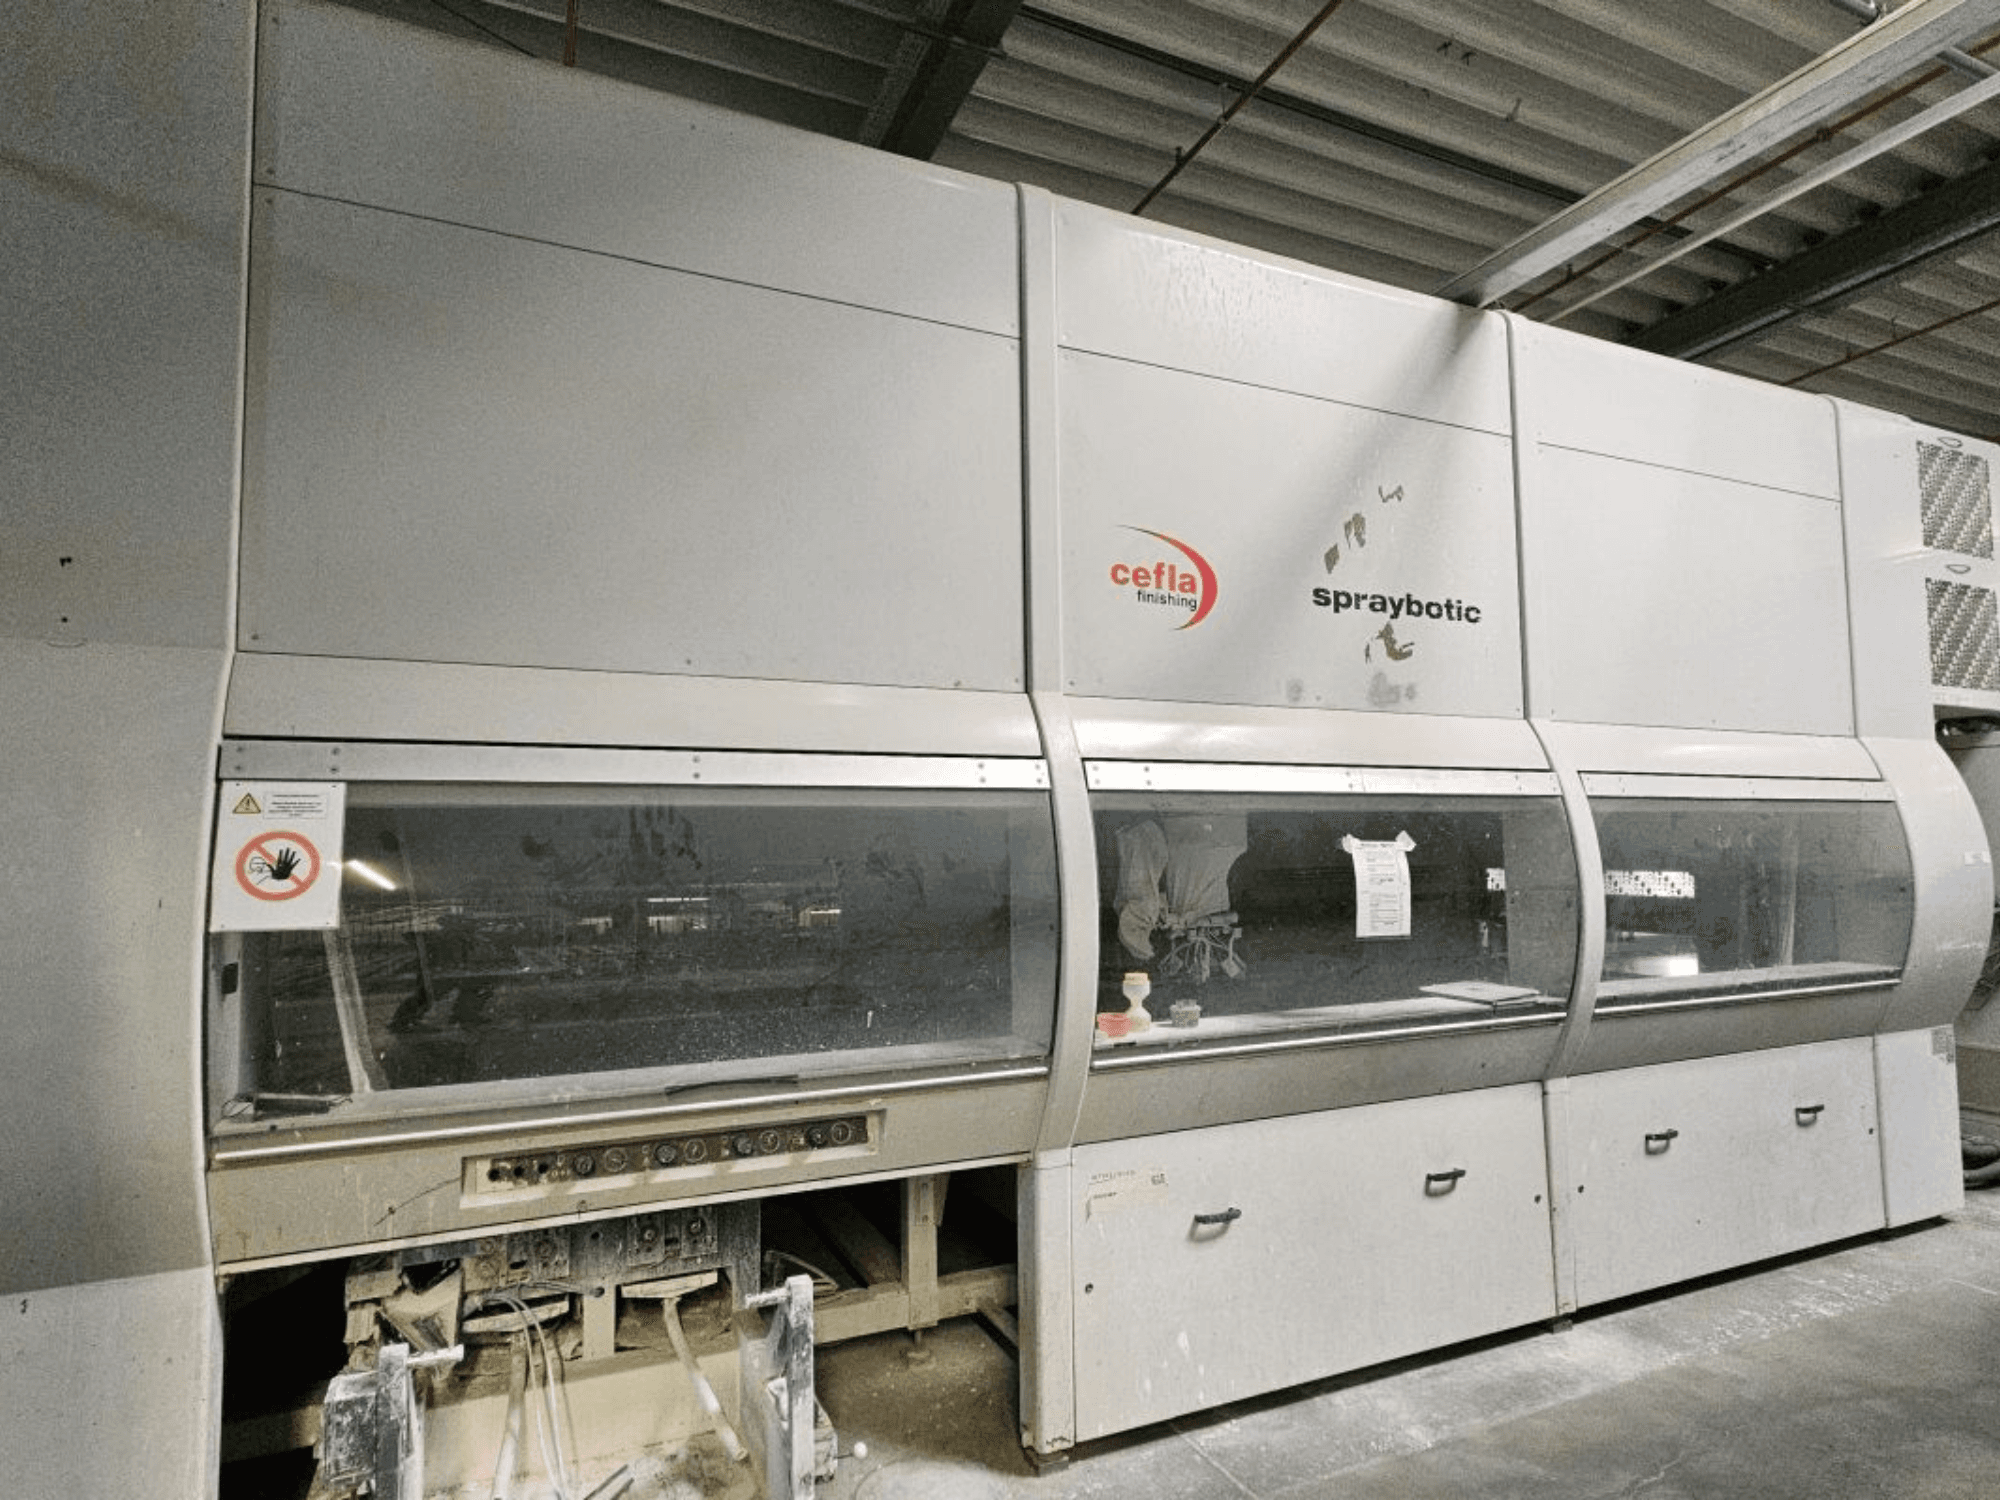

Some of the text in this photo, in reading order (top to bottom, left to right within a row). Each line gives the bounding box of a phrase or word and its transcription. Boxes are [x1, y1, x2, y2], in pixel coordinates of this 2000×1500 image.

[1110, 562, 1197, 594] cefla
[1137, 589, 1198, 612] finishing
[1312, 587, 1482, 624] spraybotic
